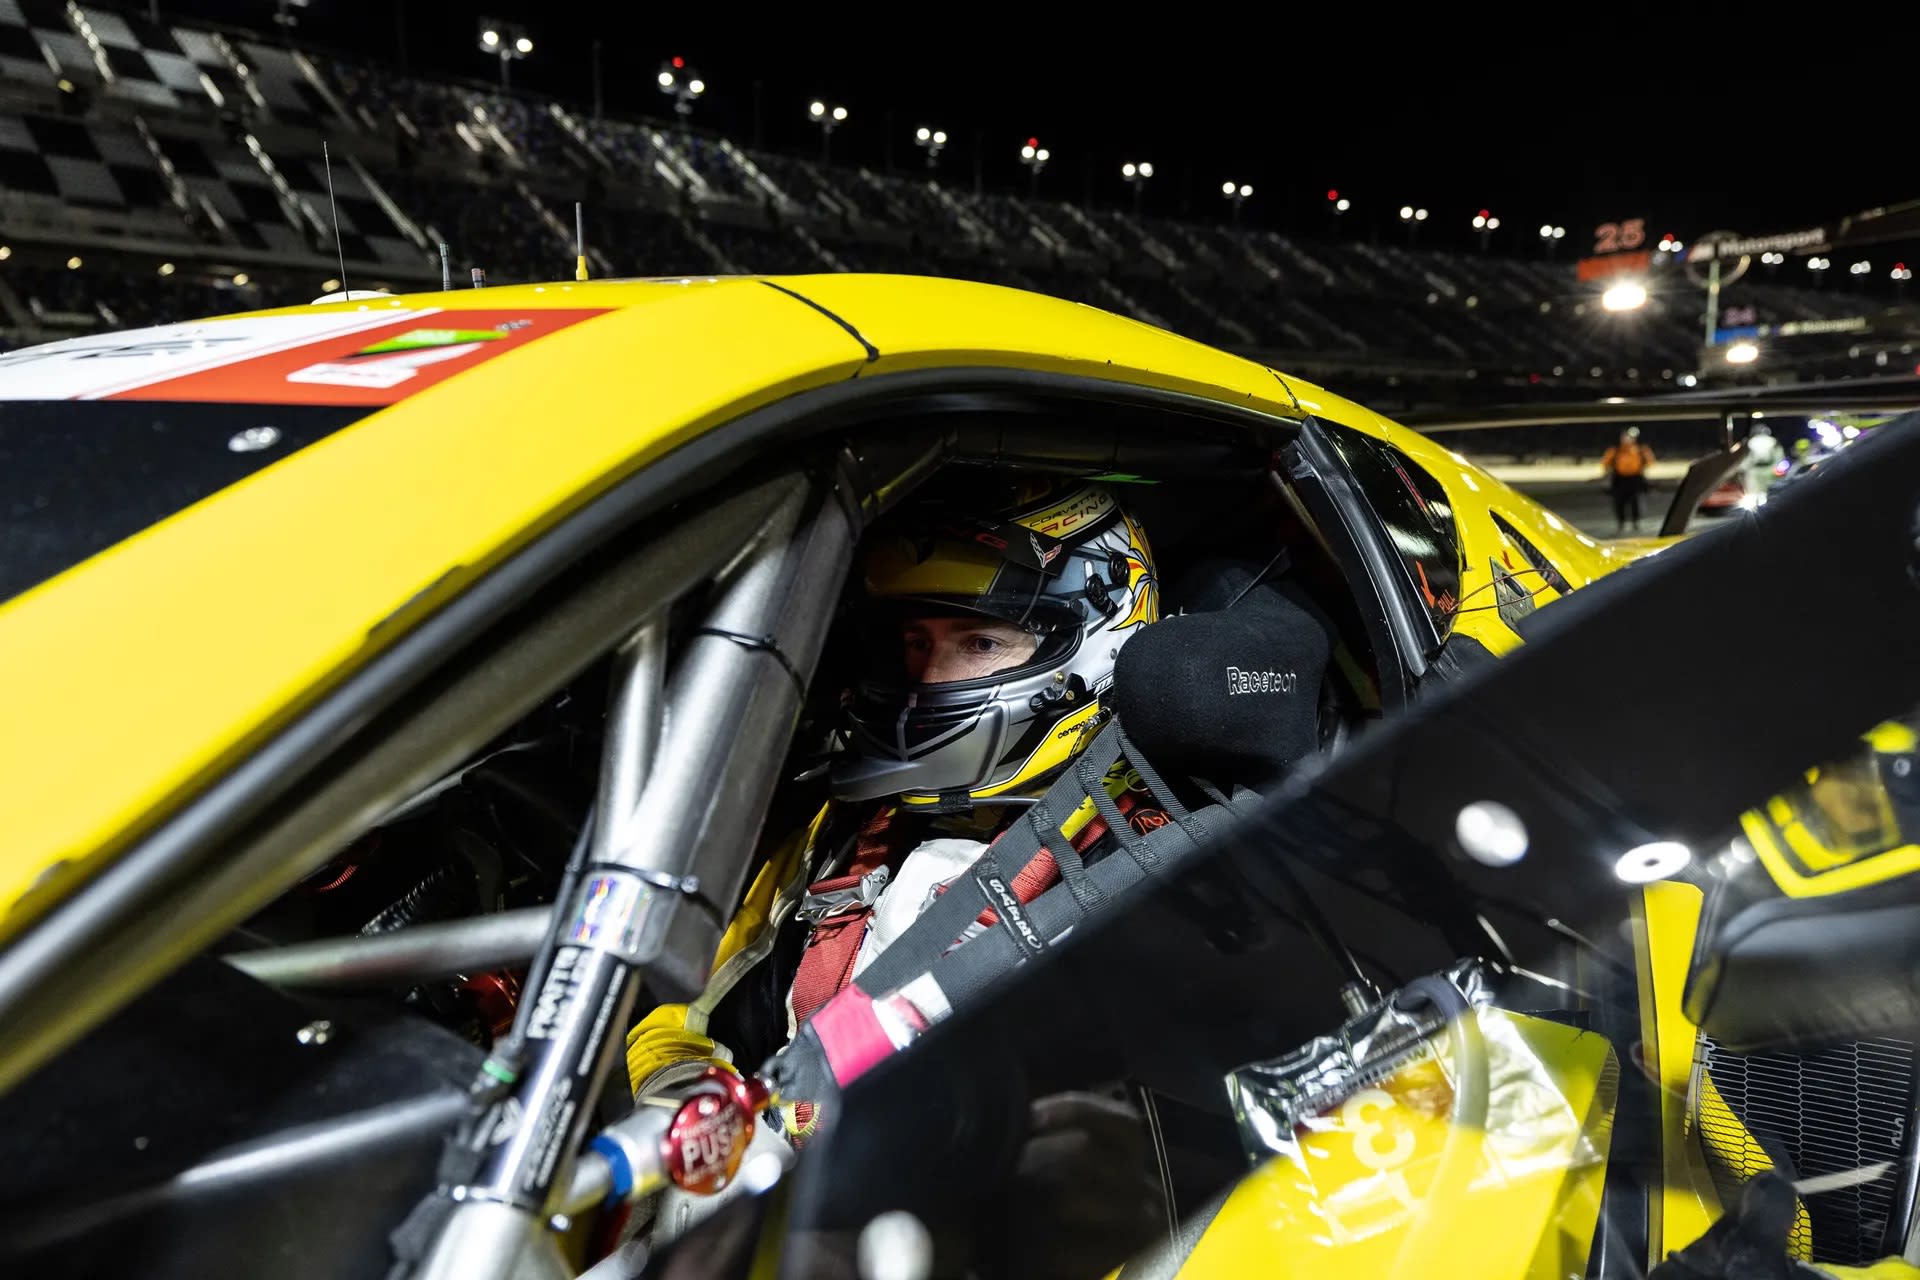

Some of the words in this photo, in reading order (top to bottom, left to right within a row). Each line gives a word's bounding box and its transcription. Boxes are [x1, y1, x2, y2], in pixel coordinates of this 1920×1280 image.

[1595, 218, 1646, 253] 25
[1029, 491, 1098, 528] CORVETTE
[1437, 589, 1456, 615] PULL
[1226, 666, 1297, 696] Racetech
